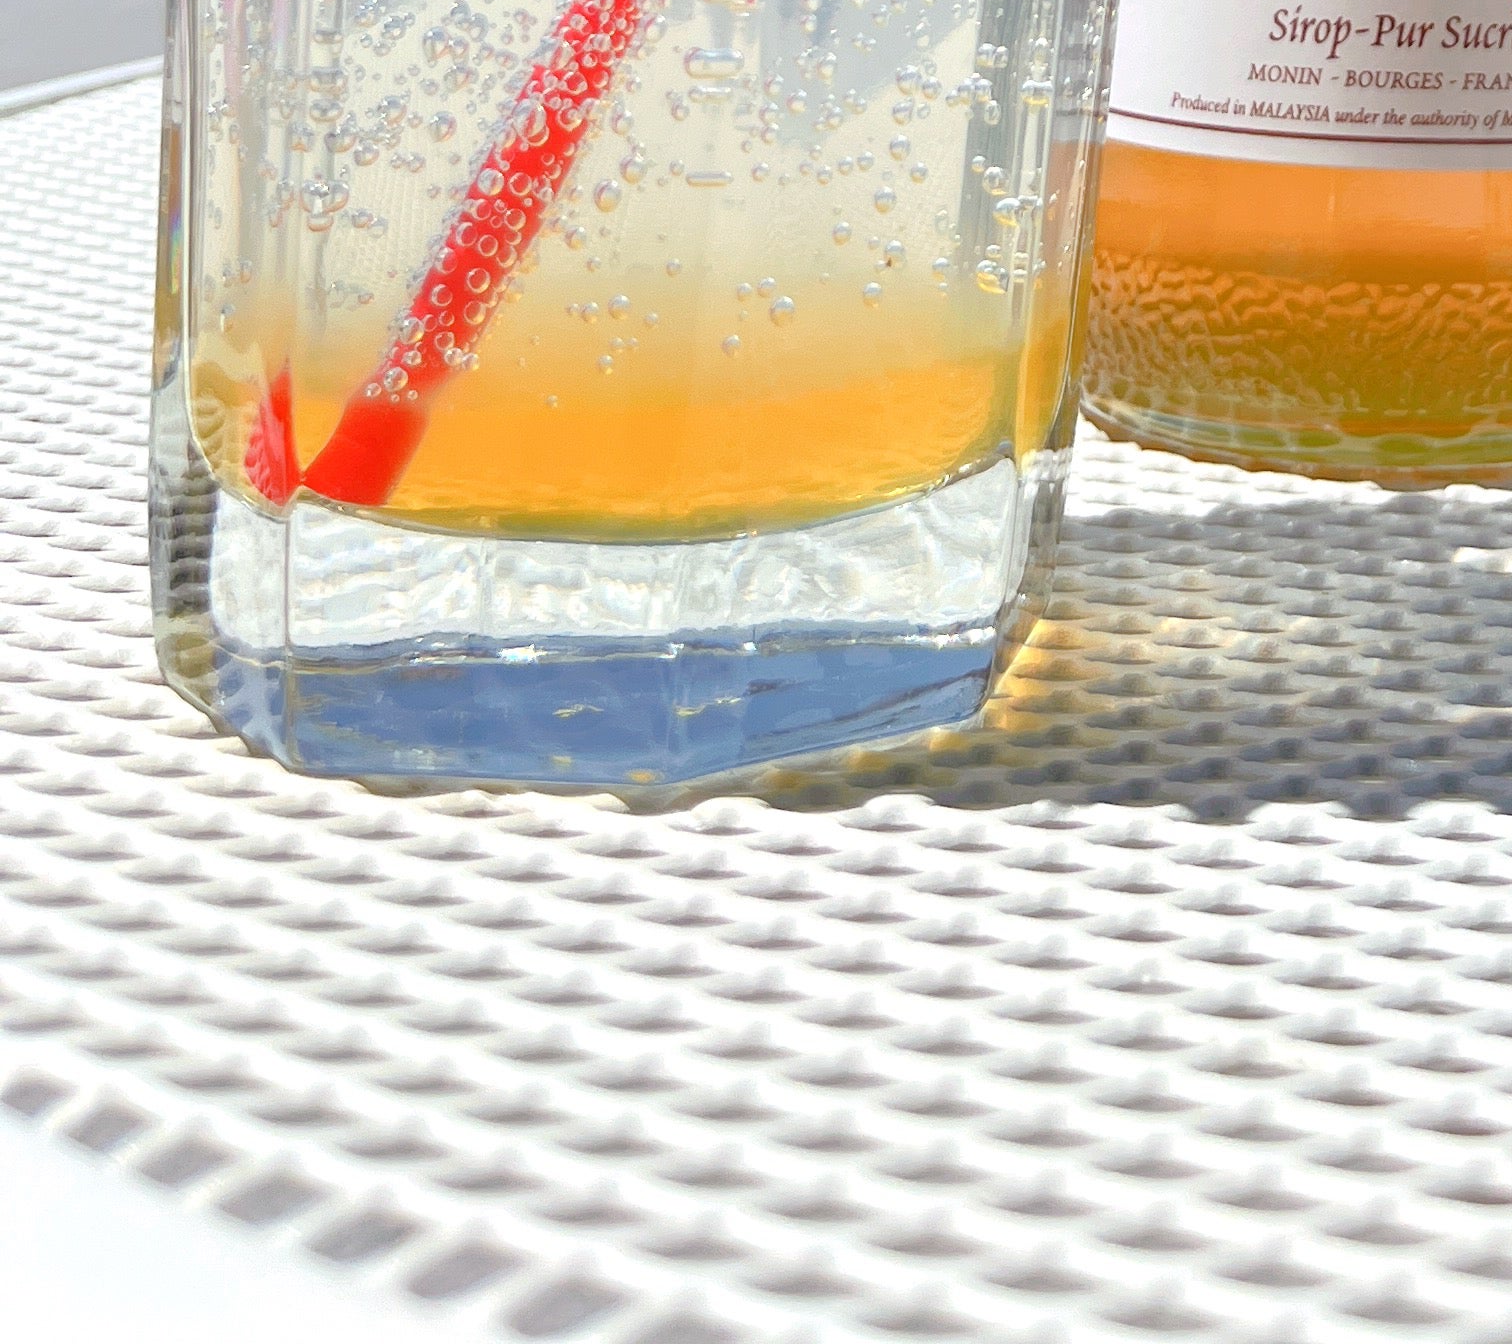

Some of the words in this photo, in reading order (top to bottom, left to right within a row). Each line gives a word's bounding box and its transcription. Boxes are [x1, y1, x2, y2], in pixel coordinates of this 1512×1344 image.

[1269, 5, 1434, 59] Sirop-Pur
[1247, 63, 1323, 86] MONIN
[1344, 69, 1444, 91] BOURGES
[1171, 91, 1230, 115] Produced
[1233, 98, 1247, 115] in
[1249, 98, 1330, 122] MALAYSIA
[1334, 105, 1376, 124] under
[1382, 108, 1405, 126] the
[1410, 108, 1478, 128] authority
[1483, 108, 1499, 130] of
